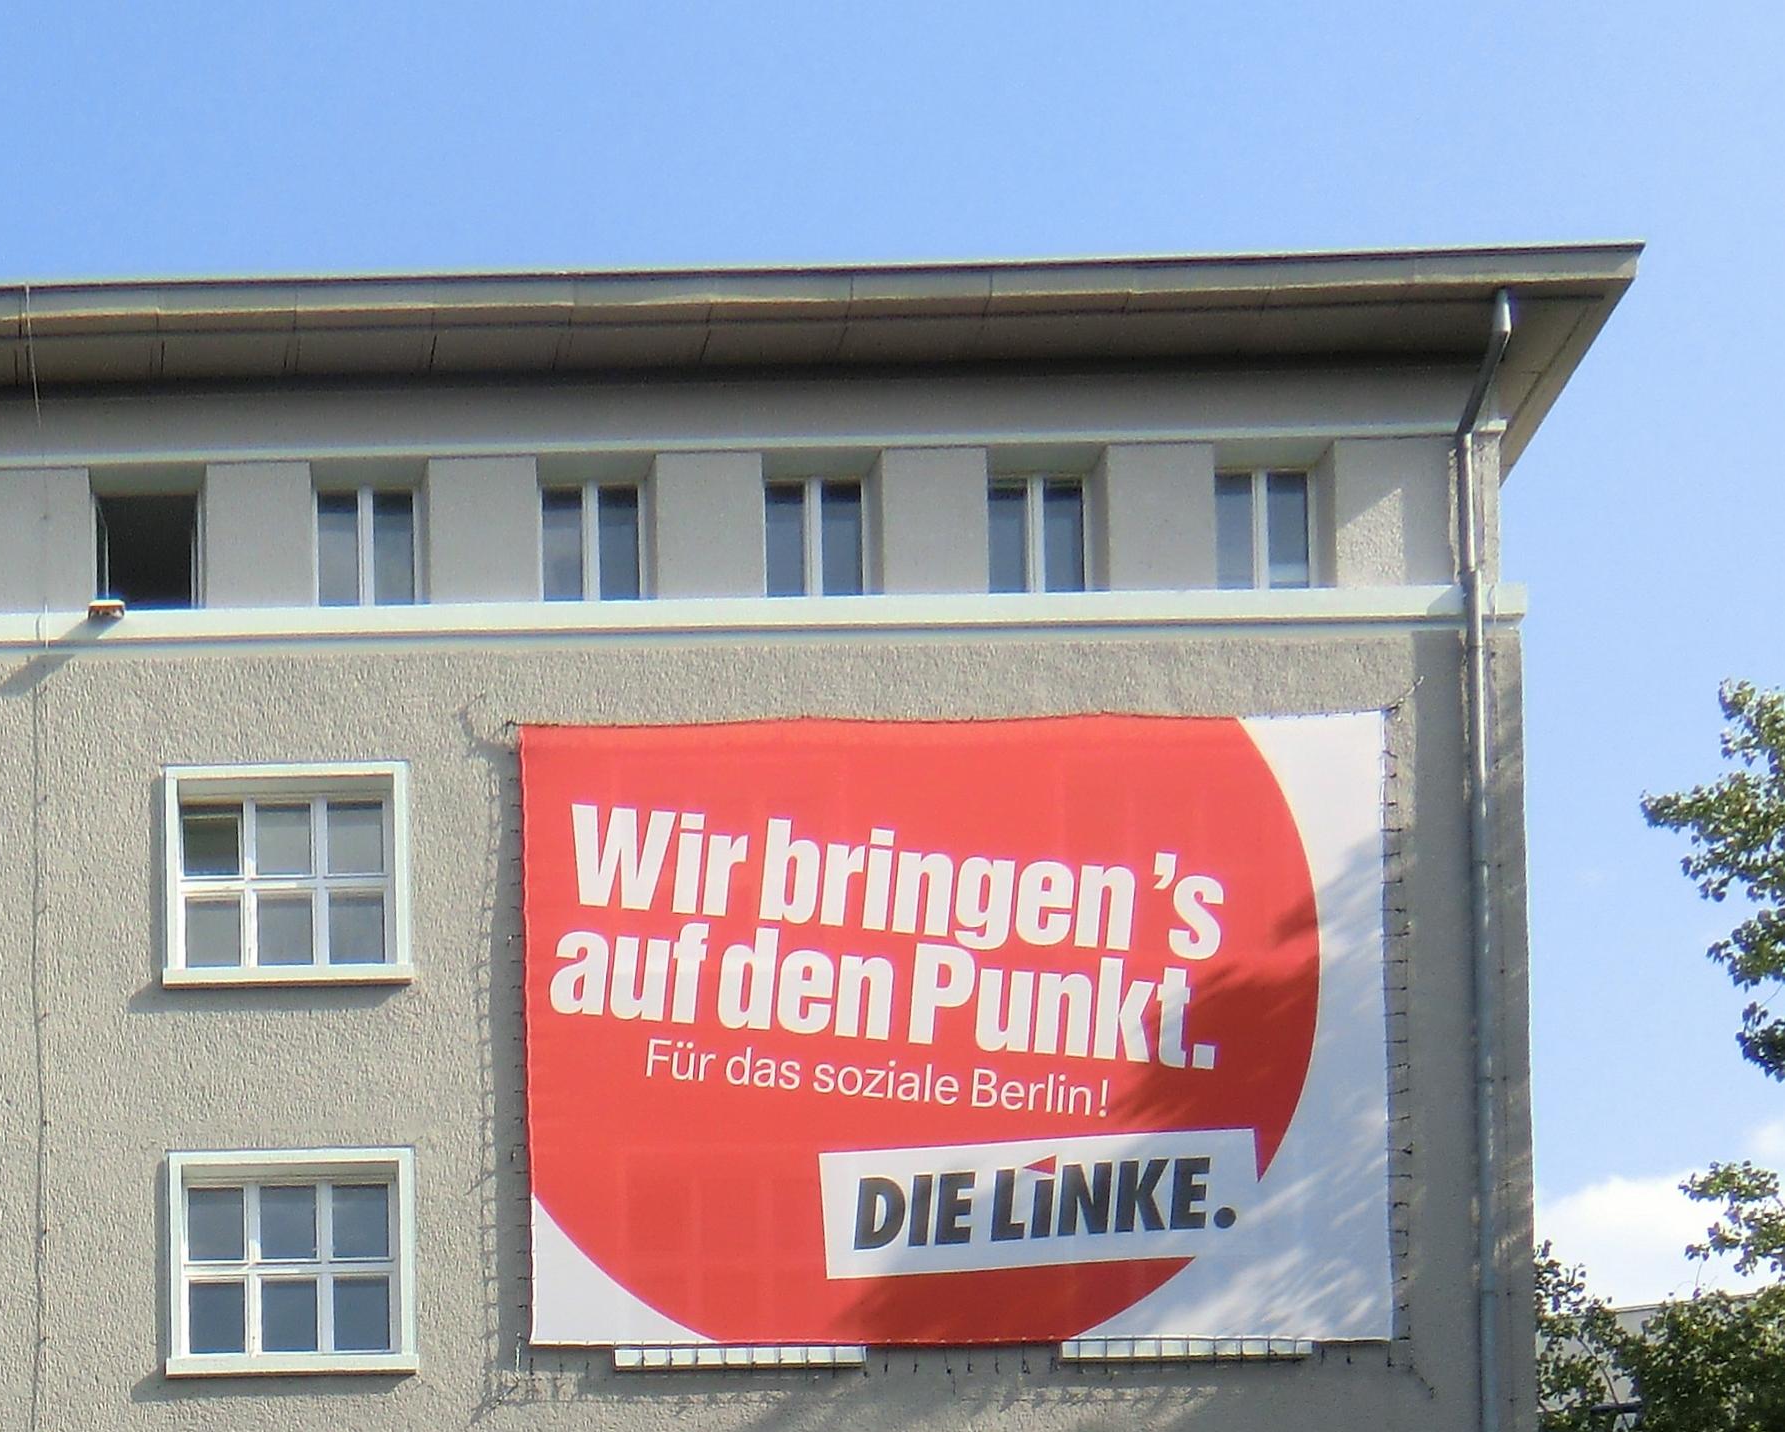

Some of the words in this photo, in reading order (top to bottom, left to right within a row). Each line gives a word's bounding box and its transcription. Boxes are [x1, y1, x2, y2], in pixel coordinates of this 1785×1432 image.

[570, 803, 749, 917] Wir
[550, 921, 709, 1024] auf
[717, 930, 894, 1041] den
[908, 942, 1217, 1070] Punkt.
[645, 1039, 716, 1083] Für
[725, 1046, 801, 1092] das
[813, 1055, 959, 1107] soziale
[971, 1068, 1110, 1118] Berlin!
[852, 1171, 975, 1252] DIE
[991, 1155, 1237, 1244] LINKE.
